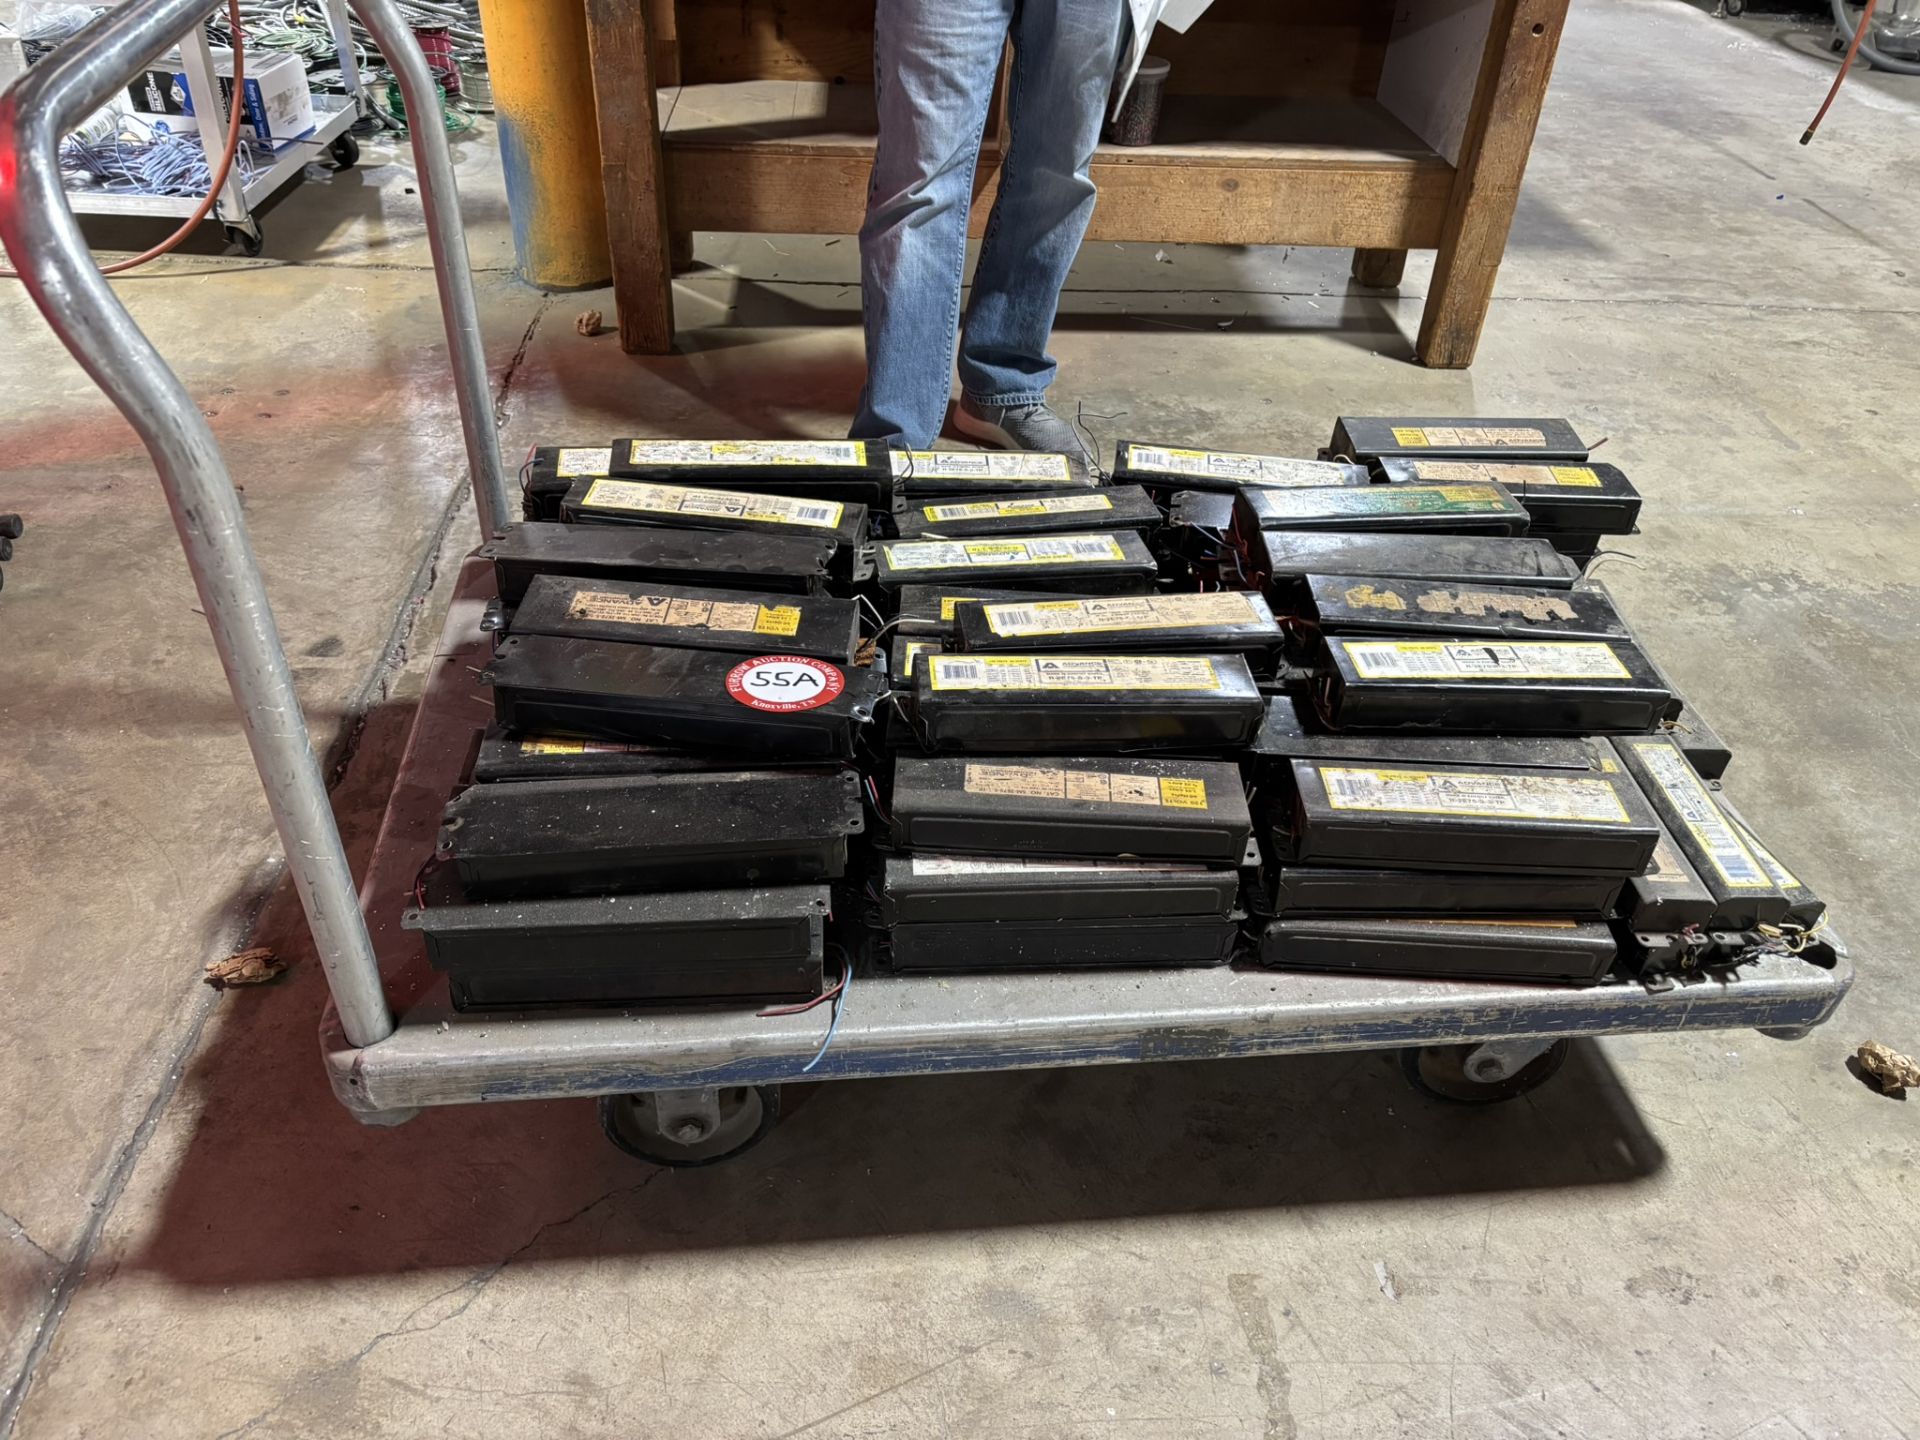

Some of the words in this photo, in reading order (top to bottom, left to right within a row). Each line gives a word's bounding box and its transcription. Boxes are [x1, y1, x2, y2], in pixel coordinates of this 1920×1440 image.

[146, 72, 163, 112] SILICONE
[727, 663, 751, 693] FURROW
[752, 655, 810, 669] AUCTION
[811, 660, 841, 694] COMPANY
[751, 699, 801, 710] Knoxville,
[802, 699, 817, 708] TN
